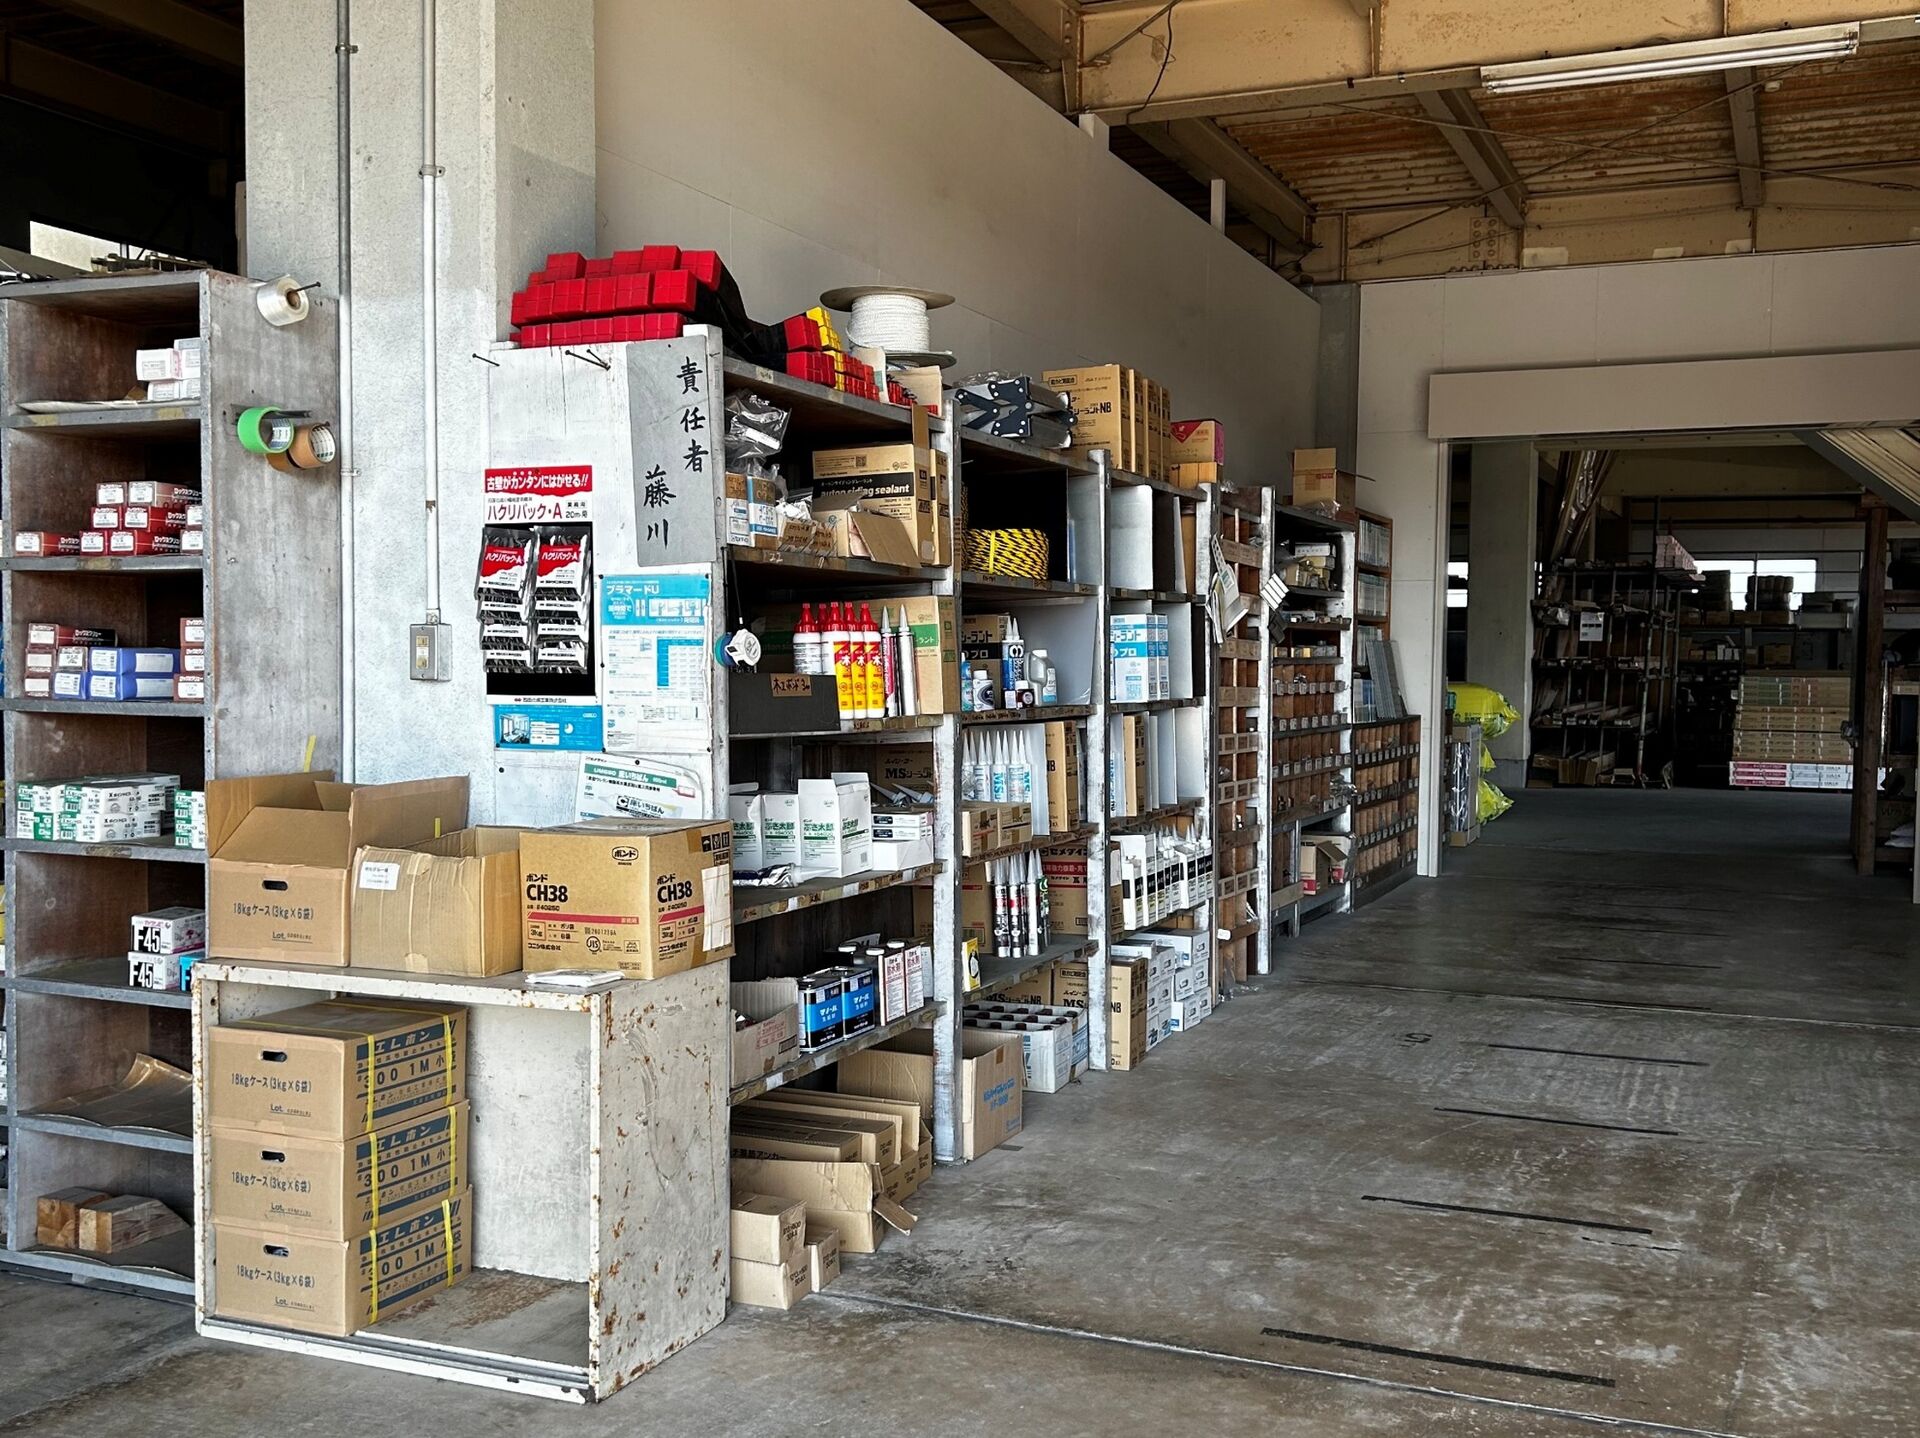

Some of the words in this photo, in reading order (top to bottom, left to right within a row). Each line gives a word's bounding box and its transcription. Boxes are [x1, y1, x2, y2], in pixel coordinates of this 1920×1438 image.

[676, 355, 709, 474] 責任者
[874, 483, 910, 495] sealant
[643, 464, 677, 549] 藤川
[606, 584, 660, 595] プラマードU
[614, 849, 636, 859] ボンド
[526, 873, 548, 883] ボンド
[657, 873, 676, 885] ボンド
[526, 884, 569, 904] CH38
[657, 880, 693, 904] CH38
[133, 924, 161, 953] F45
[527, 942, 561, 951] コニシ株式会社
[587, 939, 599, 949] JIS
[129, 960, 153, 989] F45
[375, 1031, 430, 1053] エレホン
[409, 1058, 430, 1076] 1M
[377, 1126, 431, 1150] エレホン
[364, 1164, 399, 1187] 300
[410, 1152, 431, 1171] 1M
[380, 1216, 434, 1243] エレホン
[414, 1242, 434, 1261] 1M
